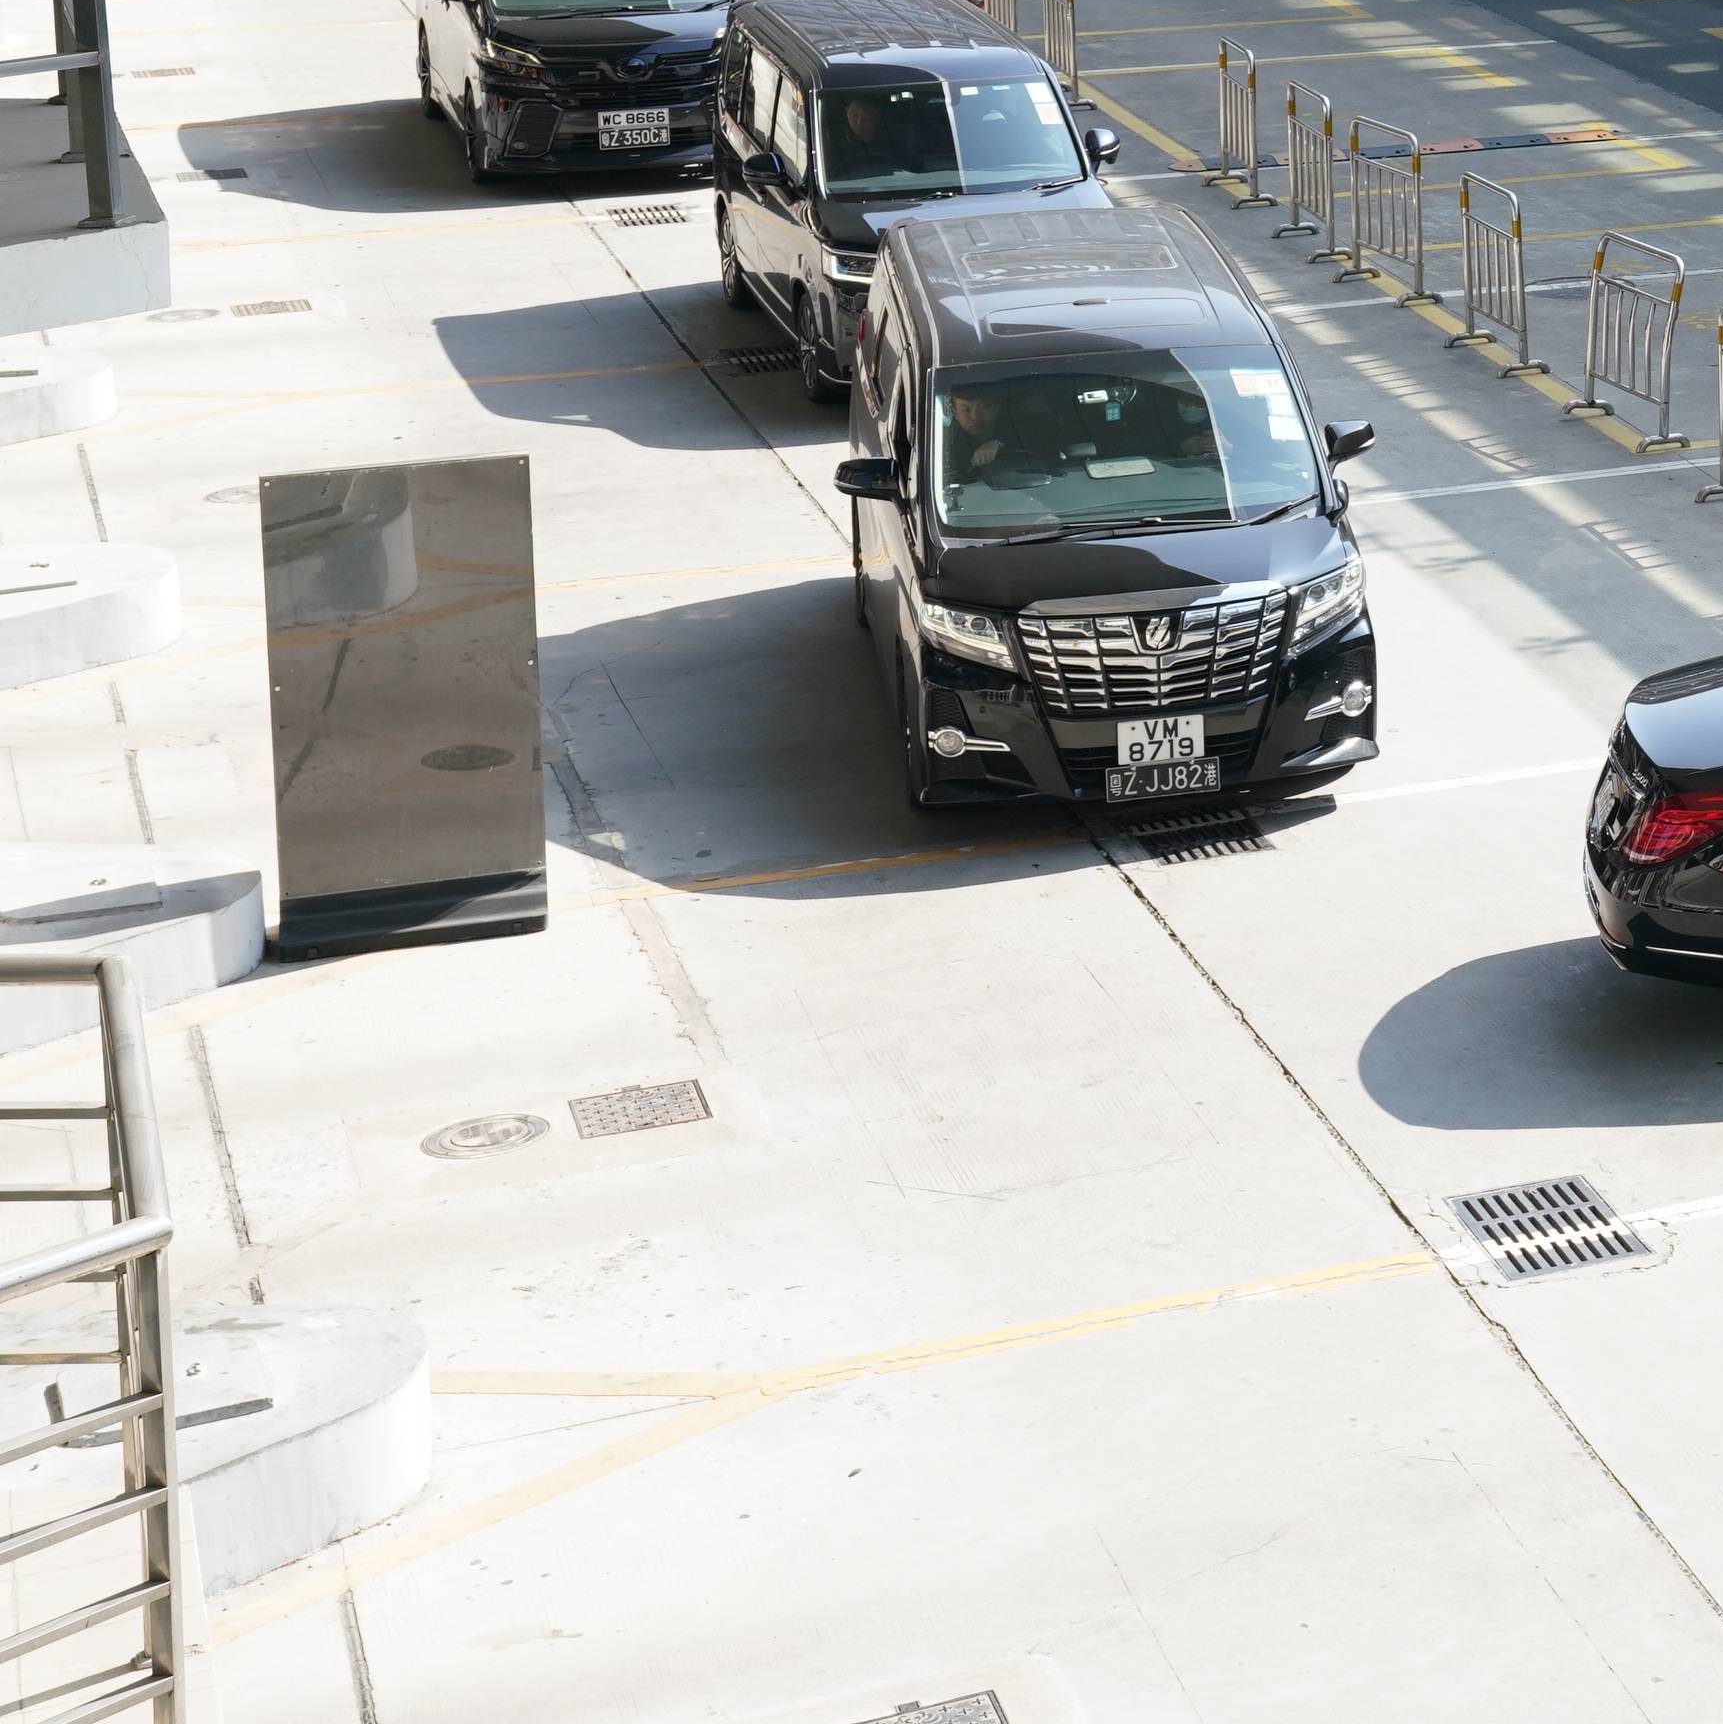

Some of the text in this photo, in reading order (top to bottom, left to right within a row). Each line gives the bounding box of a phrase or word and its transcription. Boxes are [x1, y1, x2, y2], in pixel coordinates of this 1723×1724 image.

[602, 111, 666, 126] WC 8666
[1143, 720, 1179, 740] VM
[1128, 738, 1194, 762] 8719
